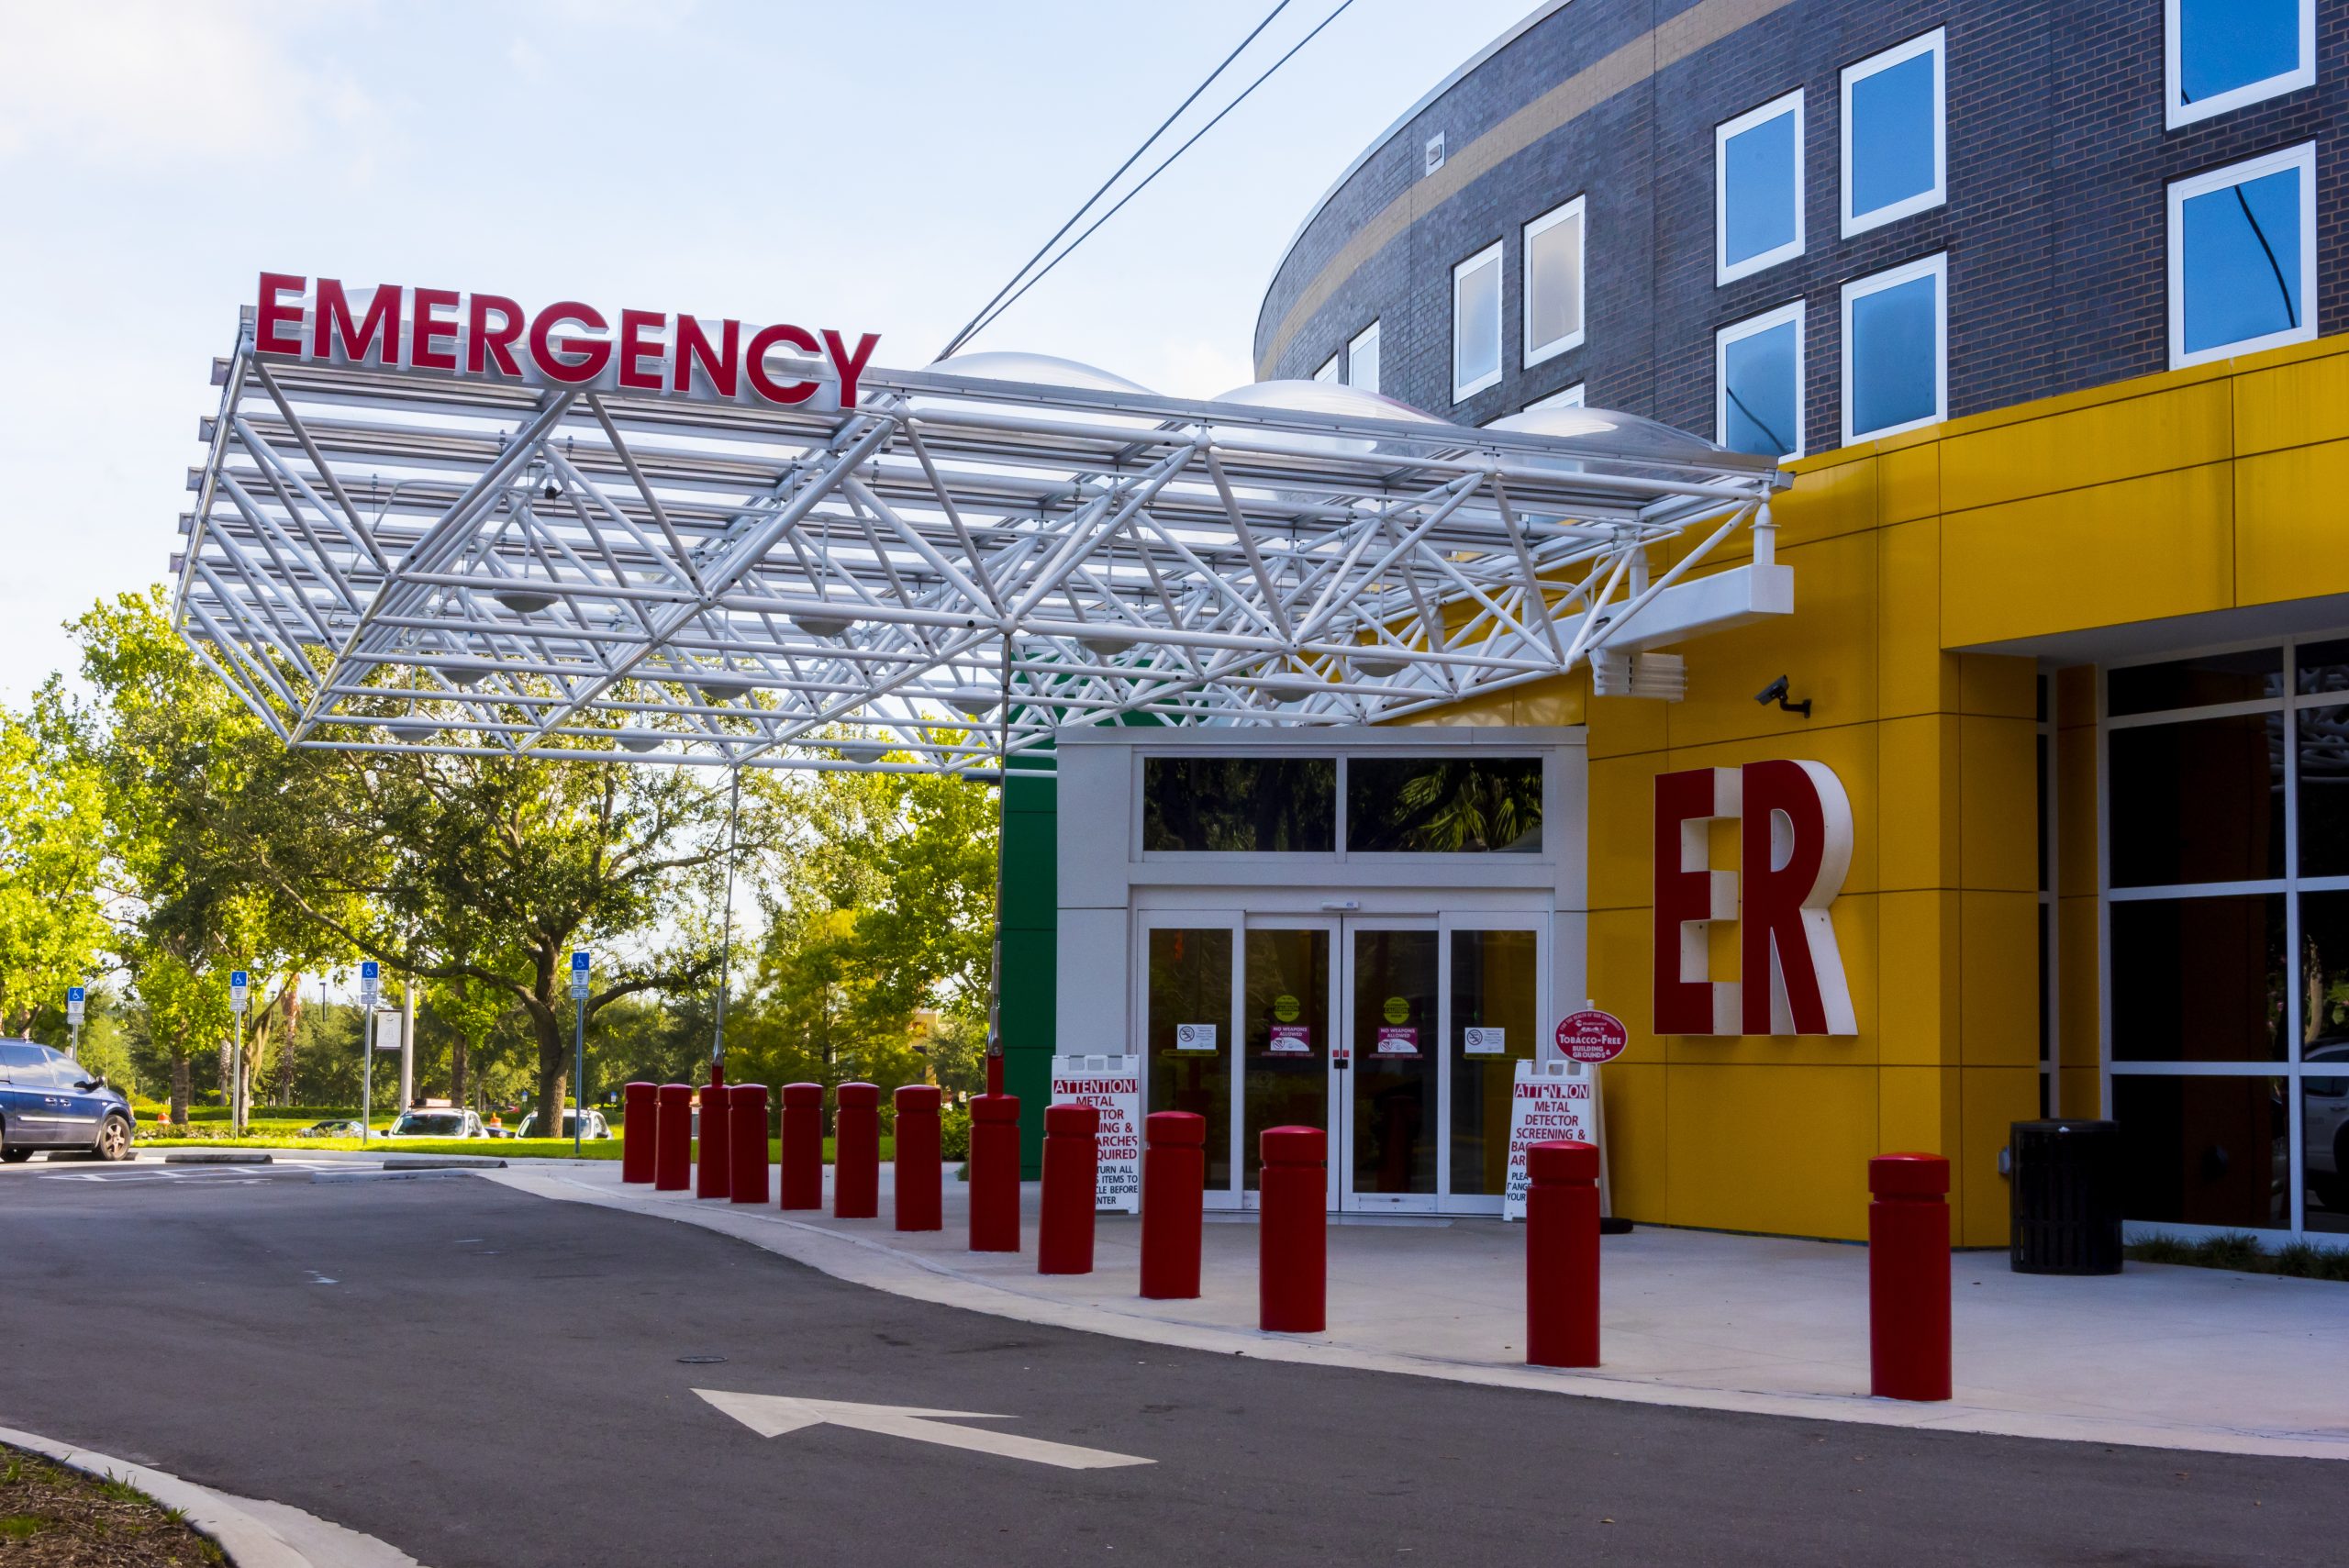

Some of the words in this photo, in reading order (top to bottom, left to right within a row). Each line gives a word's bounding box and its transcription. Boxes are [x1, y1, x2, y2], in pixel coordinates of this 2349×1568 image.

[254, 272, 882, 410] EMERGENCY
[1653, 760, 1858, 1035] ER
[1054, 1079, 1138, 1094] ATTENTION!
[1076, 1095, 1115, 1106] METAL
[1534, 1101, 1570, 1112] METAL
[1525, 1114, 1579, 1126] DETECTOR
[1125, 1122, 1133, 1133] &
[1516, 1128, 1573, 1140] SCREENING
[1577, 1129, 1586, 1140] &
[1119, 1165, 1133, 1173] ALL
[1102, 1175, 1124, 1184] ITEMS
[1127, 1174, 1138, 1184] TO
[1109, 1185, 1138, 1194] BEFORE
